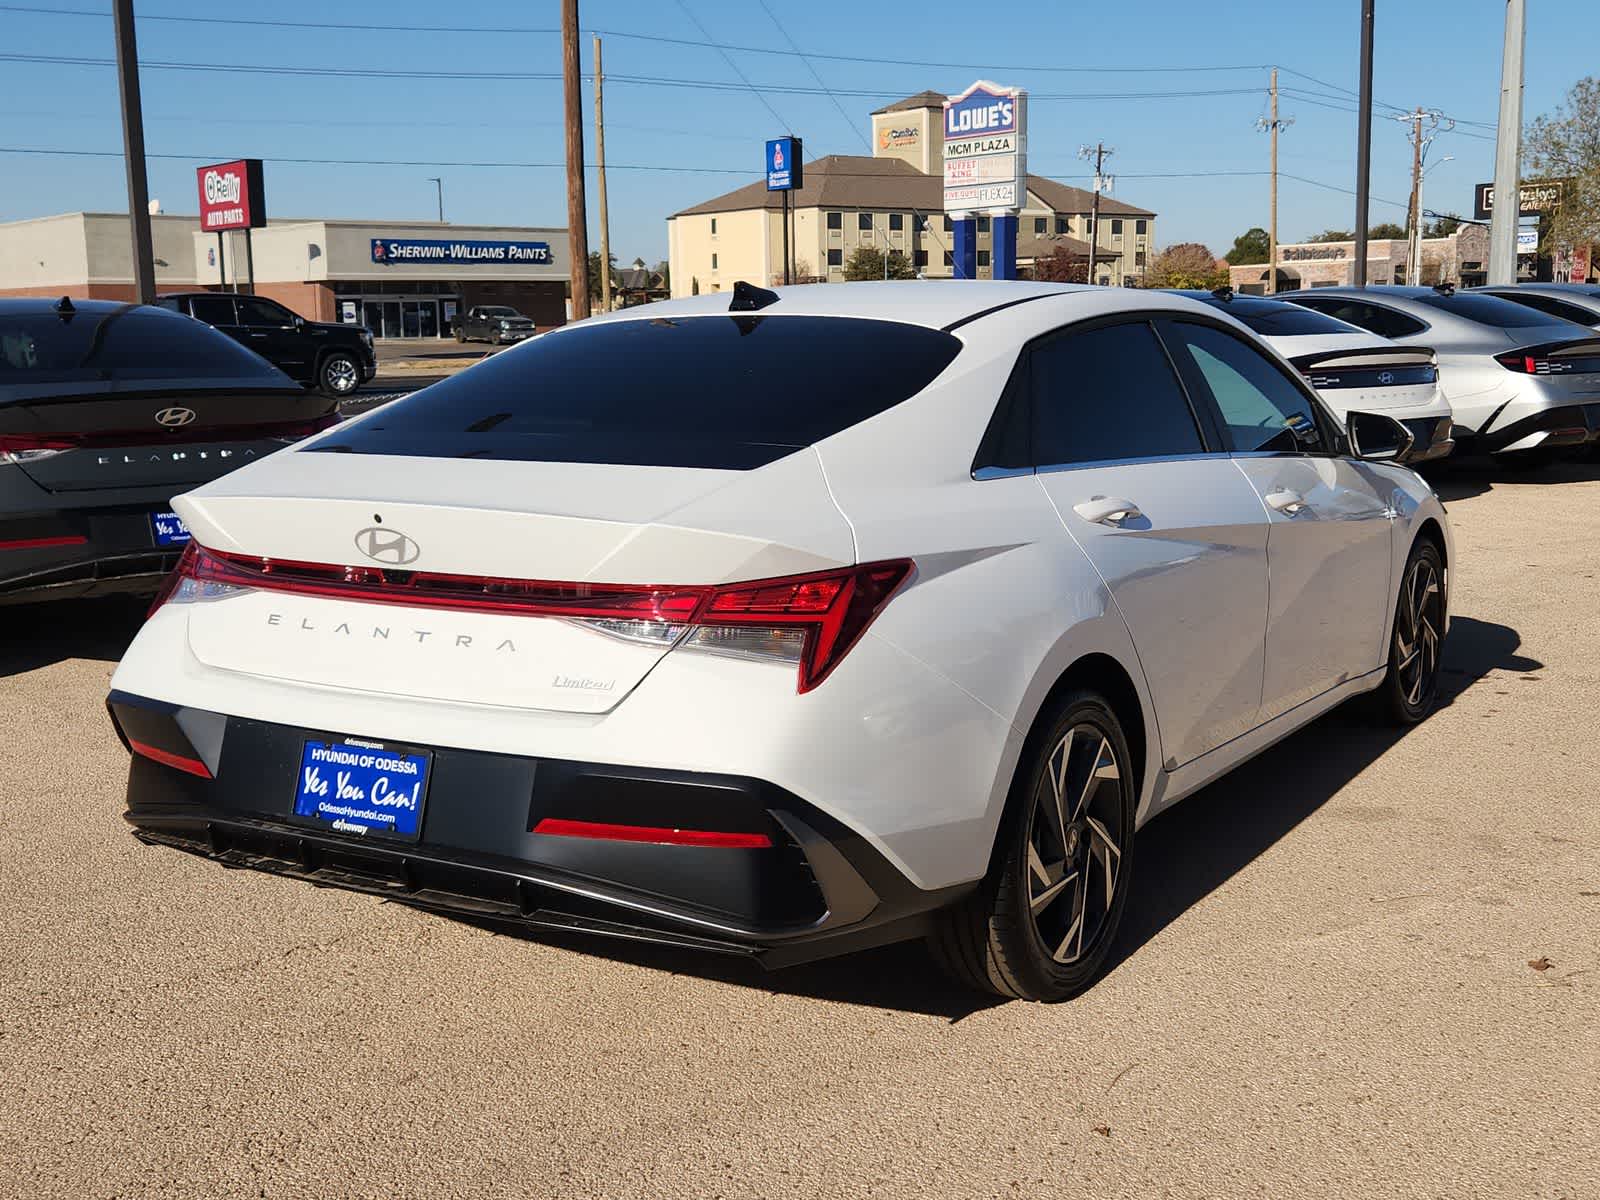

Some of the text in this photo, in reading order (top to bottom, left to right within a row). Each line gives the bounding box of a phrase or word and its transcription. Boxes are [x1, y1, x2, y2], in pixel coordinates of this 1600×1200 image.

[948, 101, 1013, 132] LOWE'S
[948, 138, 1010, 156] MCM PLAZA
[951, 170, 972, 178] KING
[205, 171, 240, 204] O'Reilly
[207, 208, 244, 226] AUTO PARTS
[389, 243, 547, 260] SHERWIN-WILLIAMS PAINTS
[156, 521, 173, 535] Yes
[267, 613, 516, 652] ELANTRA
[552, 675, 616, 690] Limited
[312, 749, 417, 775] HYUNDAI OF ODESSA
[303, 766, 420, 811] Yes You Can!
[318, 802, 395, 823] OdessaHyundai.com
[332, 819, 368, 835] driveway
